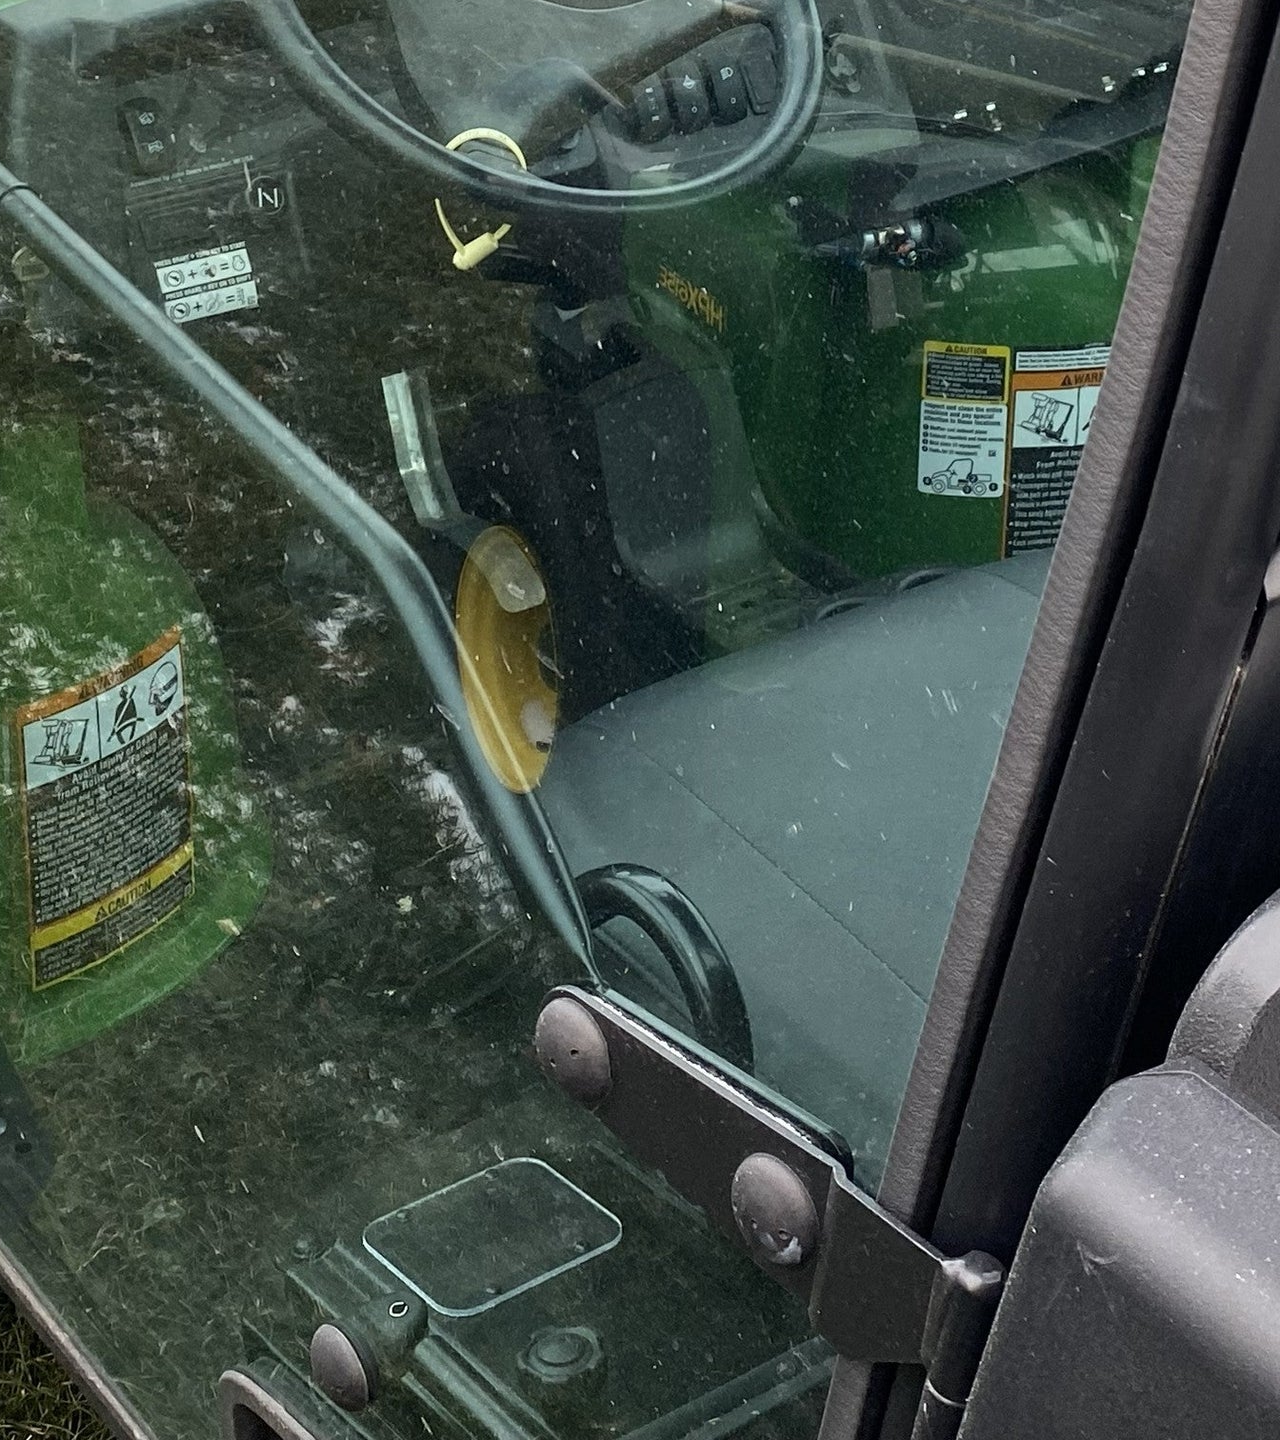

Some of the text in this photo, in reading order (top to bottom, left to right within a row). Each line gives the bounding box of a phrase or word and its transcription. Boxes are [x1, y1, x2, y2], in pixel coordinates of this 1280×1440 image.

[257, 187, 278, 208] N
[954, 345, 987, 354] CAUTION
[1074, 372, 1104, 384] WARN
[107, 879, 152, 913] CAUTION
